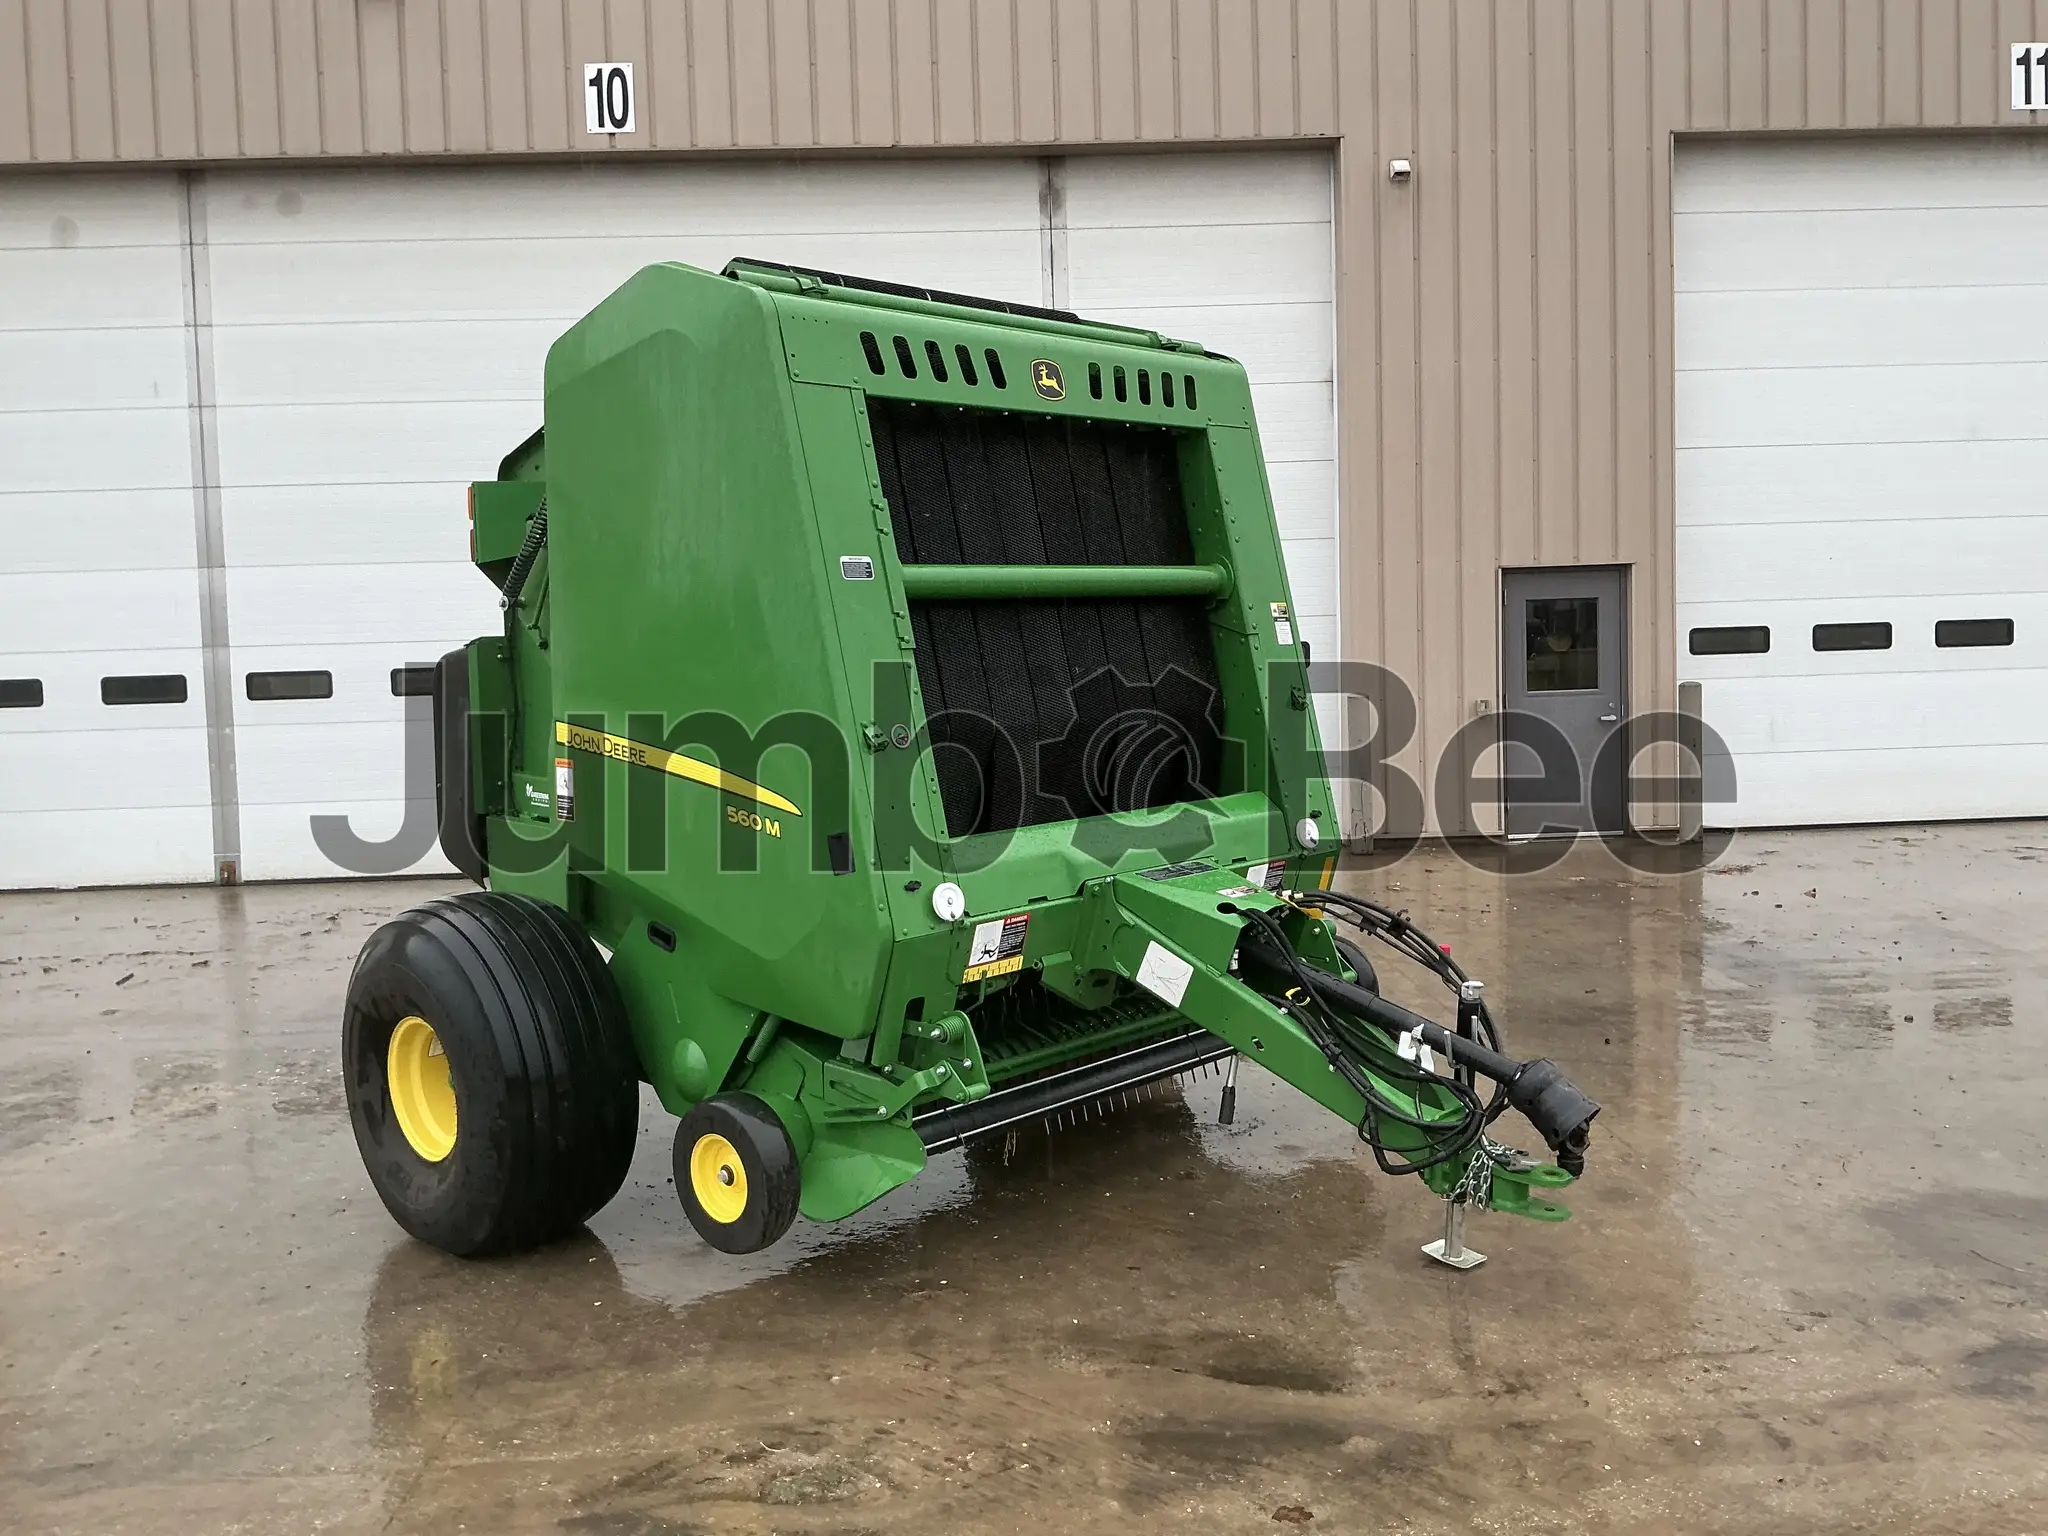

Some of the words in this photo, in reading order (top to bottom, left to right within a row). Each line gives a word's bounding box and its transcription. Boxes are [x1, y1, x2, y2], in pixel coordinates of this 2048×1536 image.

[589, 67, 629, 129] 10
[2016, 47, 2048, 105] 11
[567, 729, 600, 751] JOHN
[603, 737, 647, 764] DEERE
[726, 804, 763, 831] 560
[764, 816, 781, 840] M
